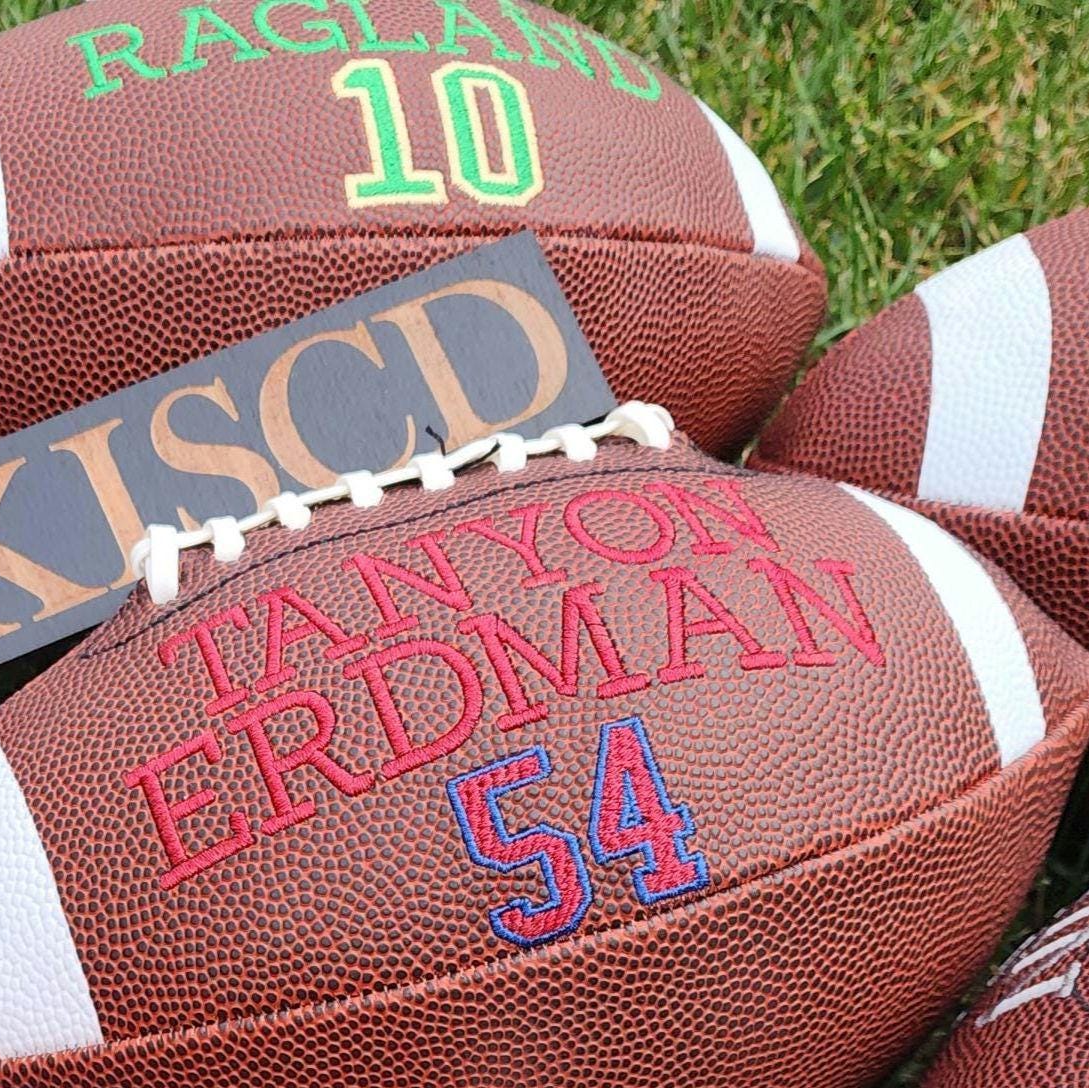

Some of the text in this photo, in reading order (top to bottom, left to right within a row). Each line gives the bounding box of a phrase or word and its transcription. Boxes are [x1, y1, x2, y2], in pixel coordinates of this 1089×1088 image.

[66, 0, 662, 101] RAGLAND
[330, 57, 545, 208] 10
[159, 480, 782, 716] TANYON
[123, 557, 887, 892] ERDMAN
[445, 715, 712, 949] 54
